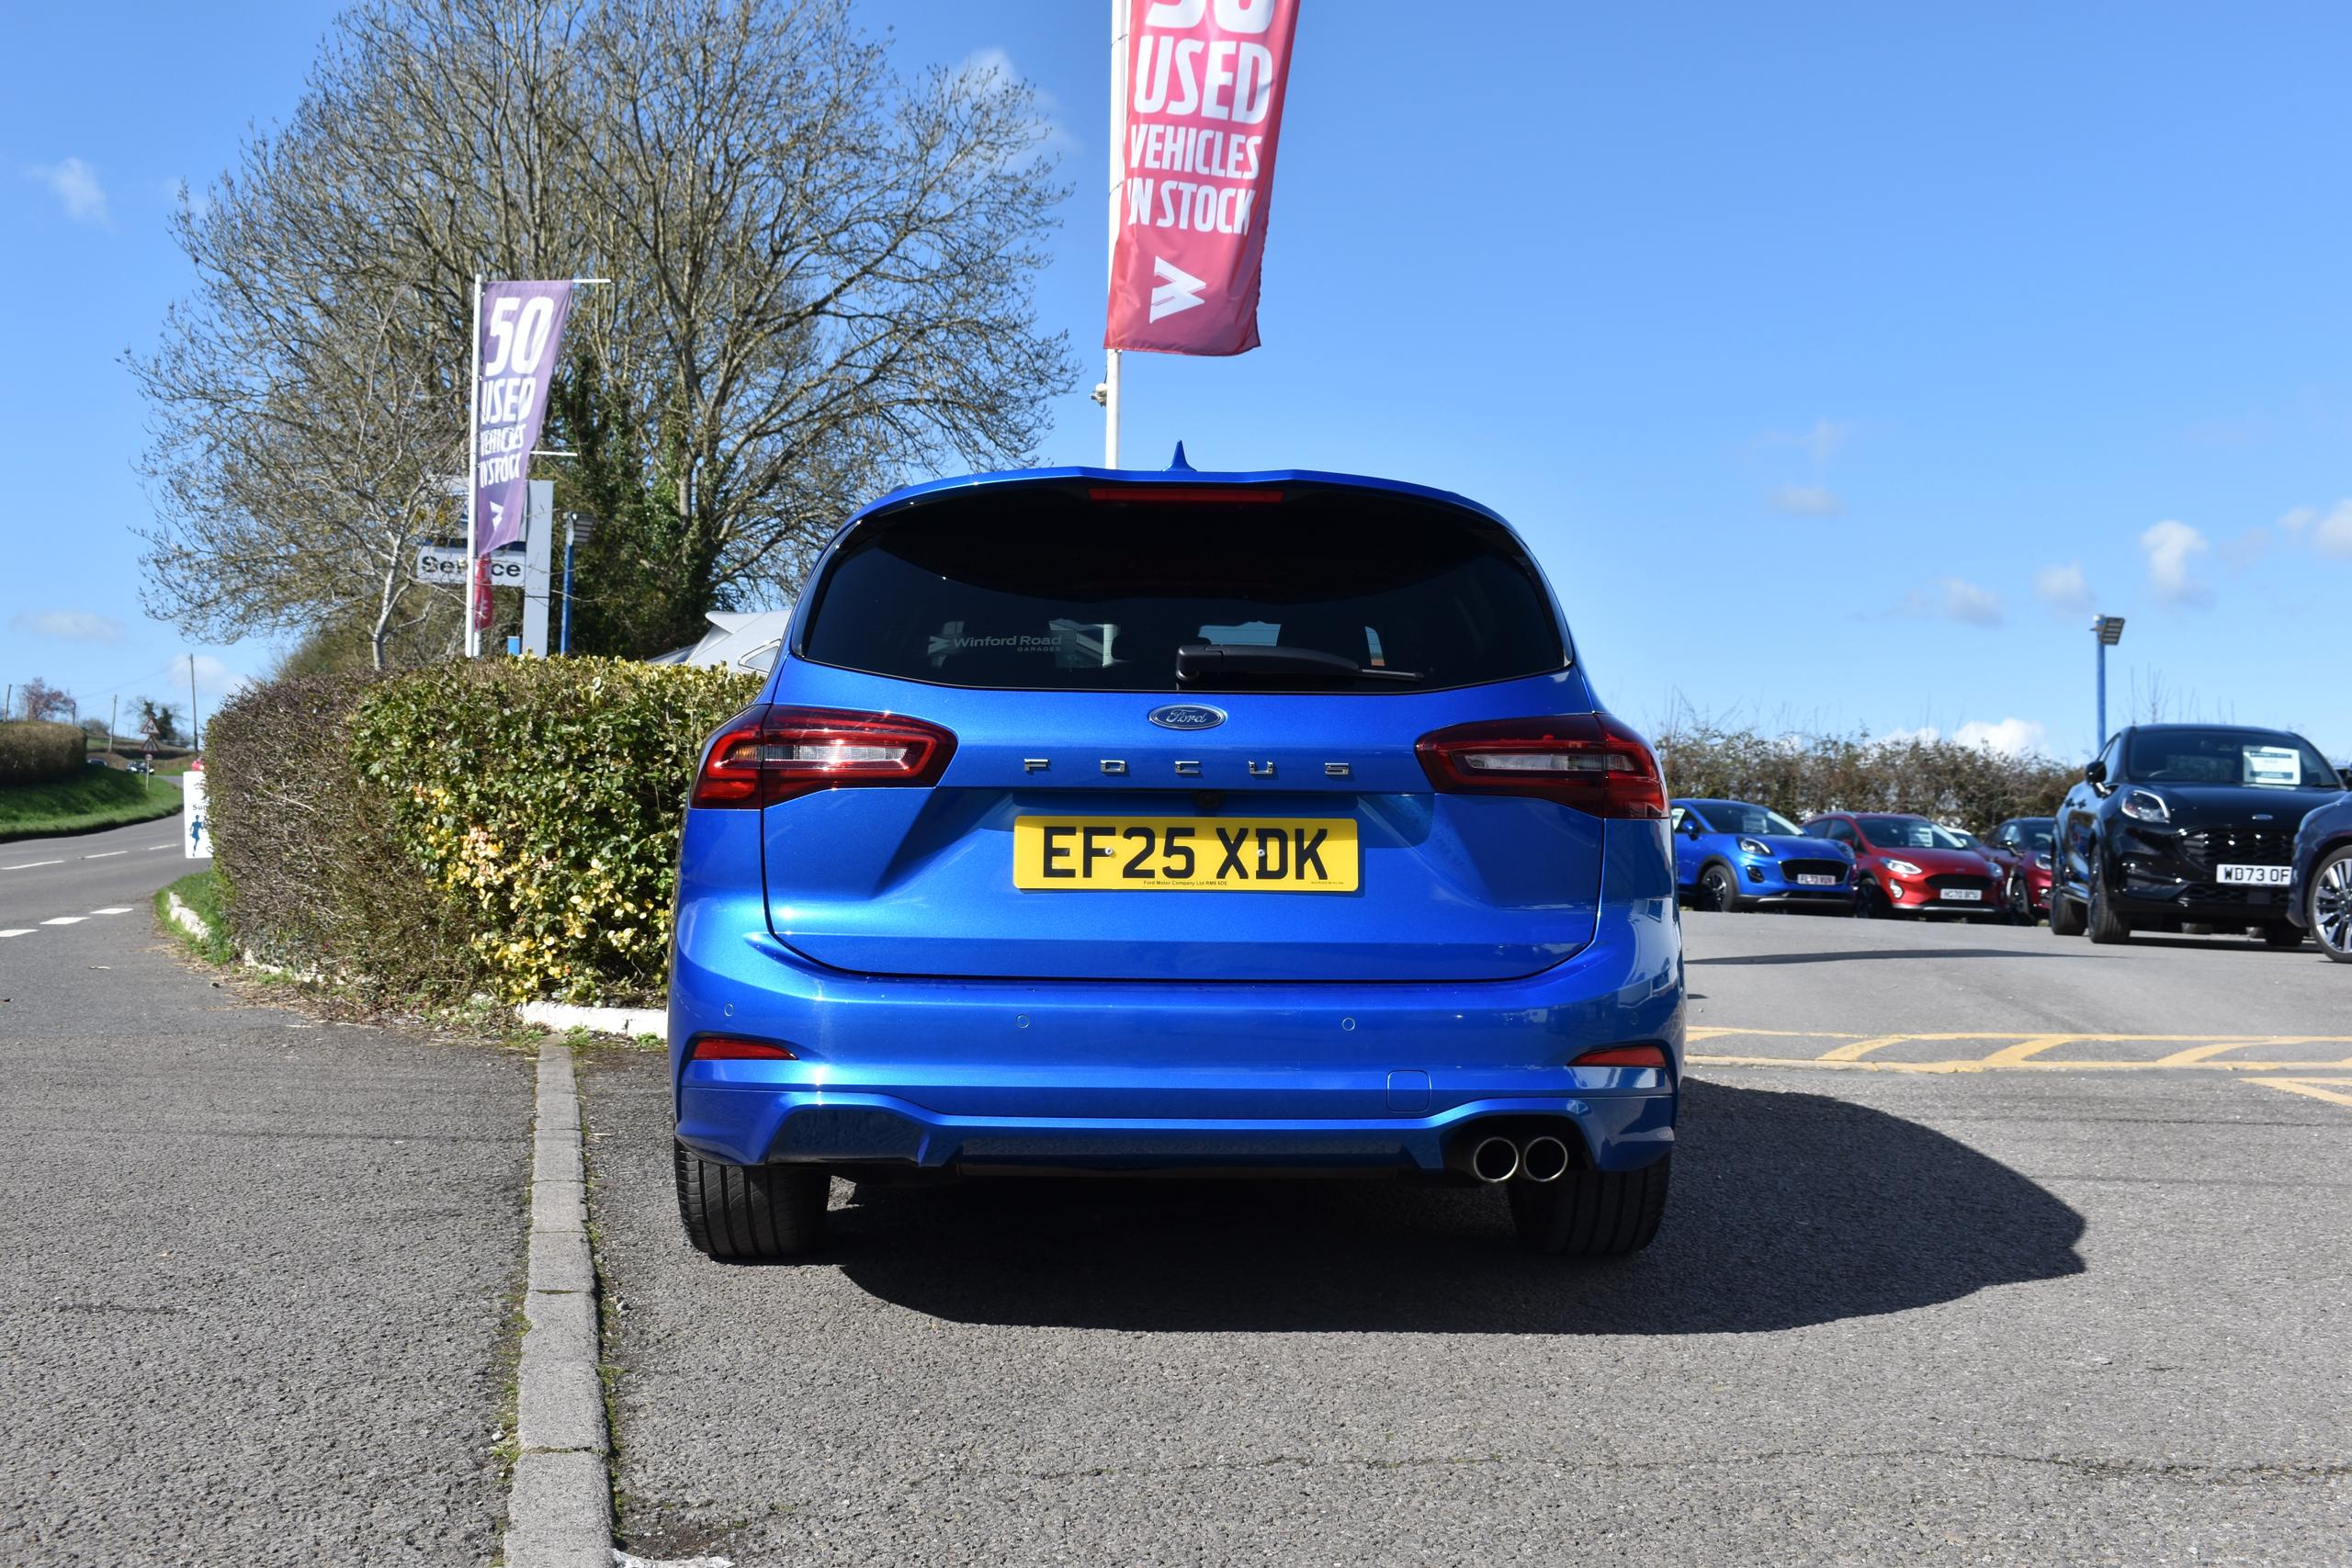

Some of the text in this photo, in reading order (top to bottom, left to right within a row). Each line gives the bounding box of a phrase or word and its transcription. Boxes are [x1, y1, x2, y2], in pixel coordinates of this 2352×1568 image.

[1134, 36, 1273, 124] USED
[1130, 124, 1262, 180] VEHICLES
[1127, 177, 1256, 235] IN STOCK
[485, 296, 554, 378] 50
[481, 377, 536, 425] USED
[422, 556, 521, 577] Sece
[954, 634, 1062, 647] Winford Road
[1166, 709, 1208, 723] Ford
[1023, 758, 1350, 776] FOCUS
[1043, 826, 1329, 880] EF25 XDK
[2224, 866, 2290, 883] WD73 OF
